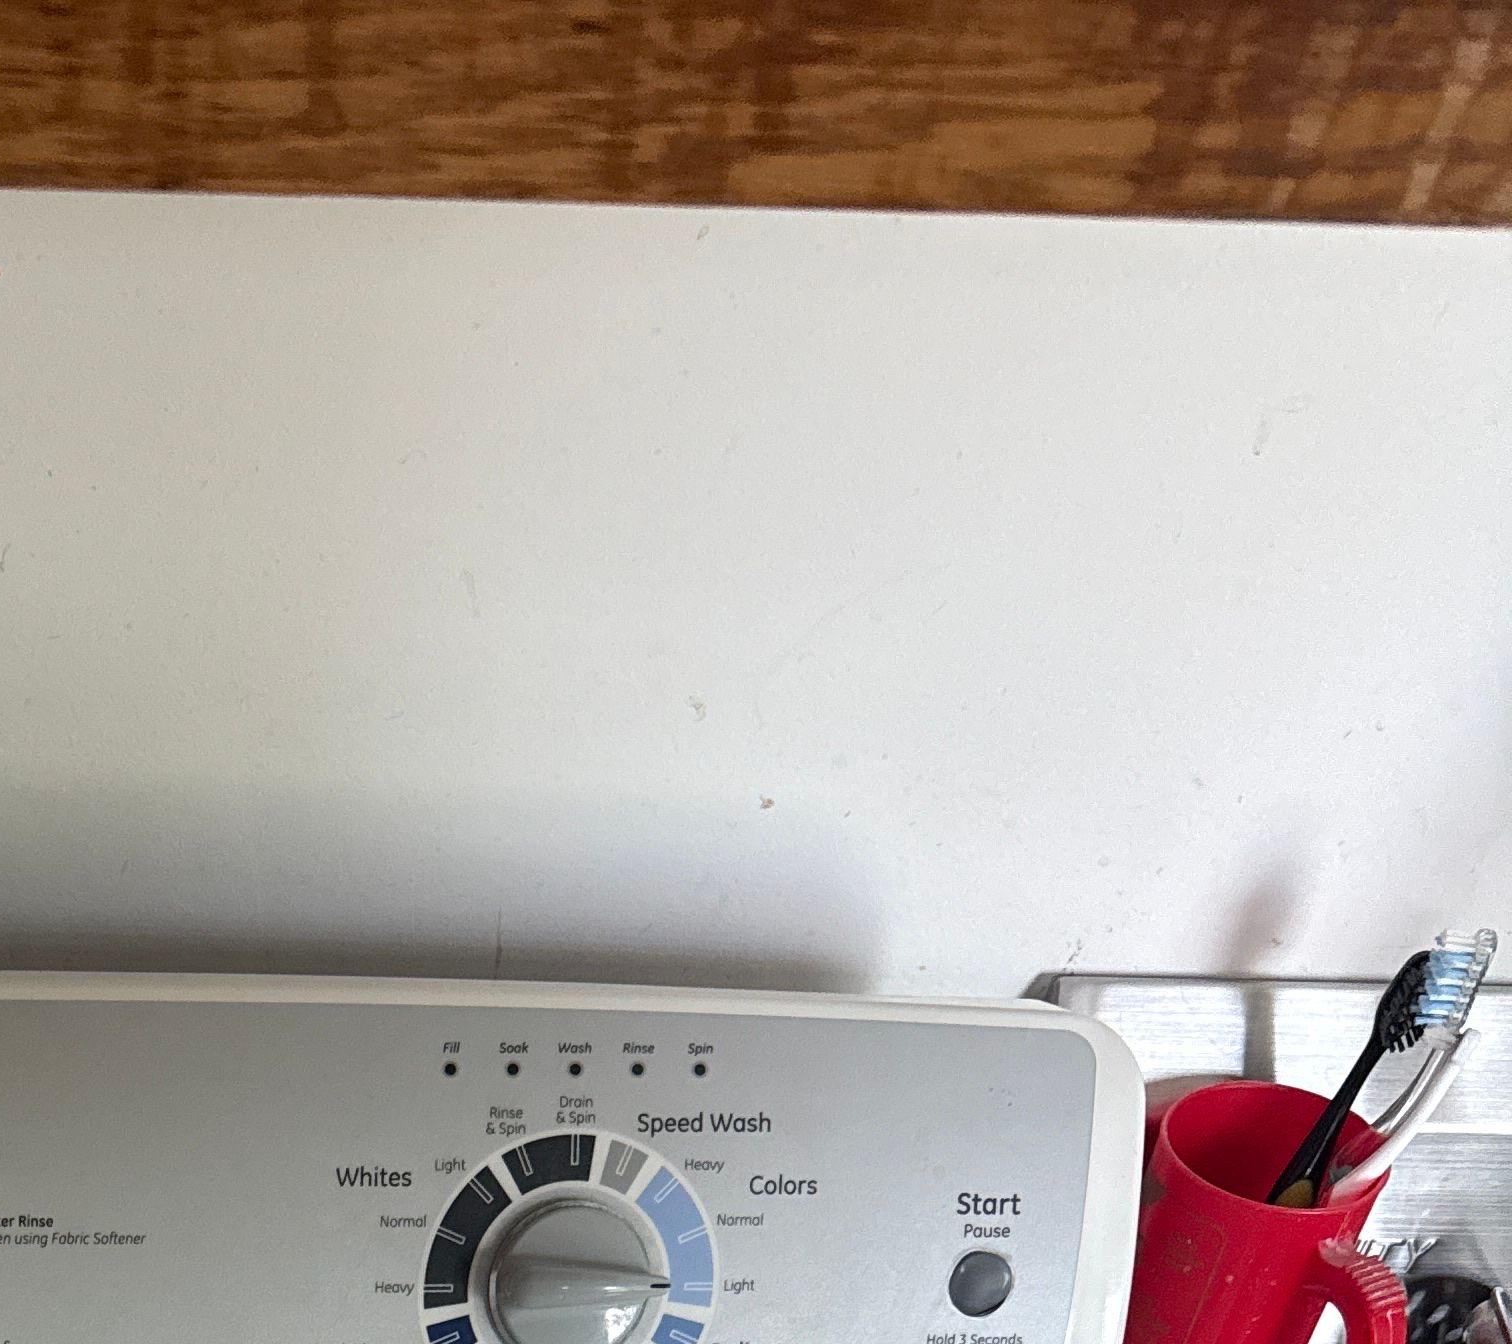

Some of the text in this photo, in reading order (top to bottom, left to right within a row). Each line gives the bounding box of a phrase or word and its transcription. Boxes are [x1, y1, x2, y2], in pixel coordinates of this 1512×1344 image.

[443, 1042, 460, 1053] Fill
[500, 1042, 528, 1053] Soak
[558, 1042, 592, 1053] Wash
[623, 1043, 655, 1053] Rinse
[688, 1043, 713, 1056] Spin
[560, 1096, 593, 1108] Drain
[490, 1107, 523, 1119] Rinse
[556, 1111, 595, 1126] & Spin
[486, 1122, 526, 1137] & Spin
[638, 1112, 770, 1137] Speed Wash
[435, 1158, 465, 1174] Light
[685, 1159, 724, 1173] Heavy
[336, 1166, 411, 1187] Whites
[750, 1174, 817, 1195] Colors
[957, 1193, 1021, 1215] Start
[19, 1216, 53, 1227] Rinse
[380, 1215, 426, 1228] Normal
[717, 1213, 763, 1226] Normal
[964, 1224, 1010, 1238] Pause
[15, 1235, 48, 1248] using
[52, 1232, 89, 1245] Fabric
[94, 1231, 146, 1245] Softener
[375, 1282, 414, 1296] Heavy
[724, 1279, 754, 1294] Light
[927, 1334, 1022, 1344] Hold 3 Seconds
